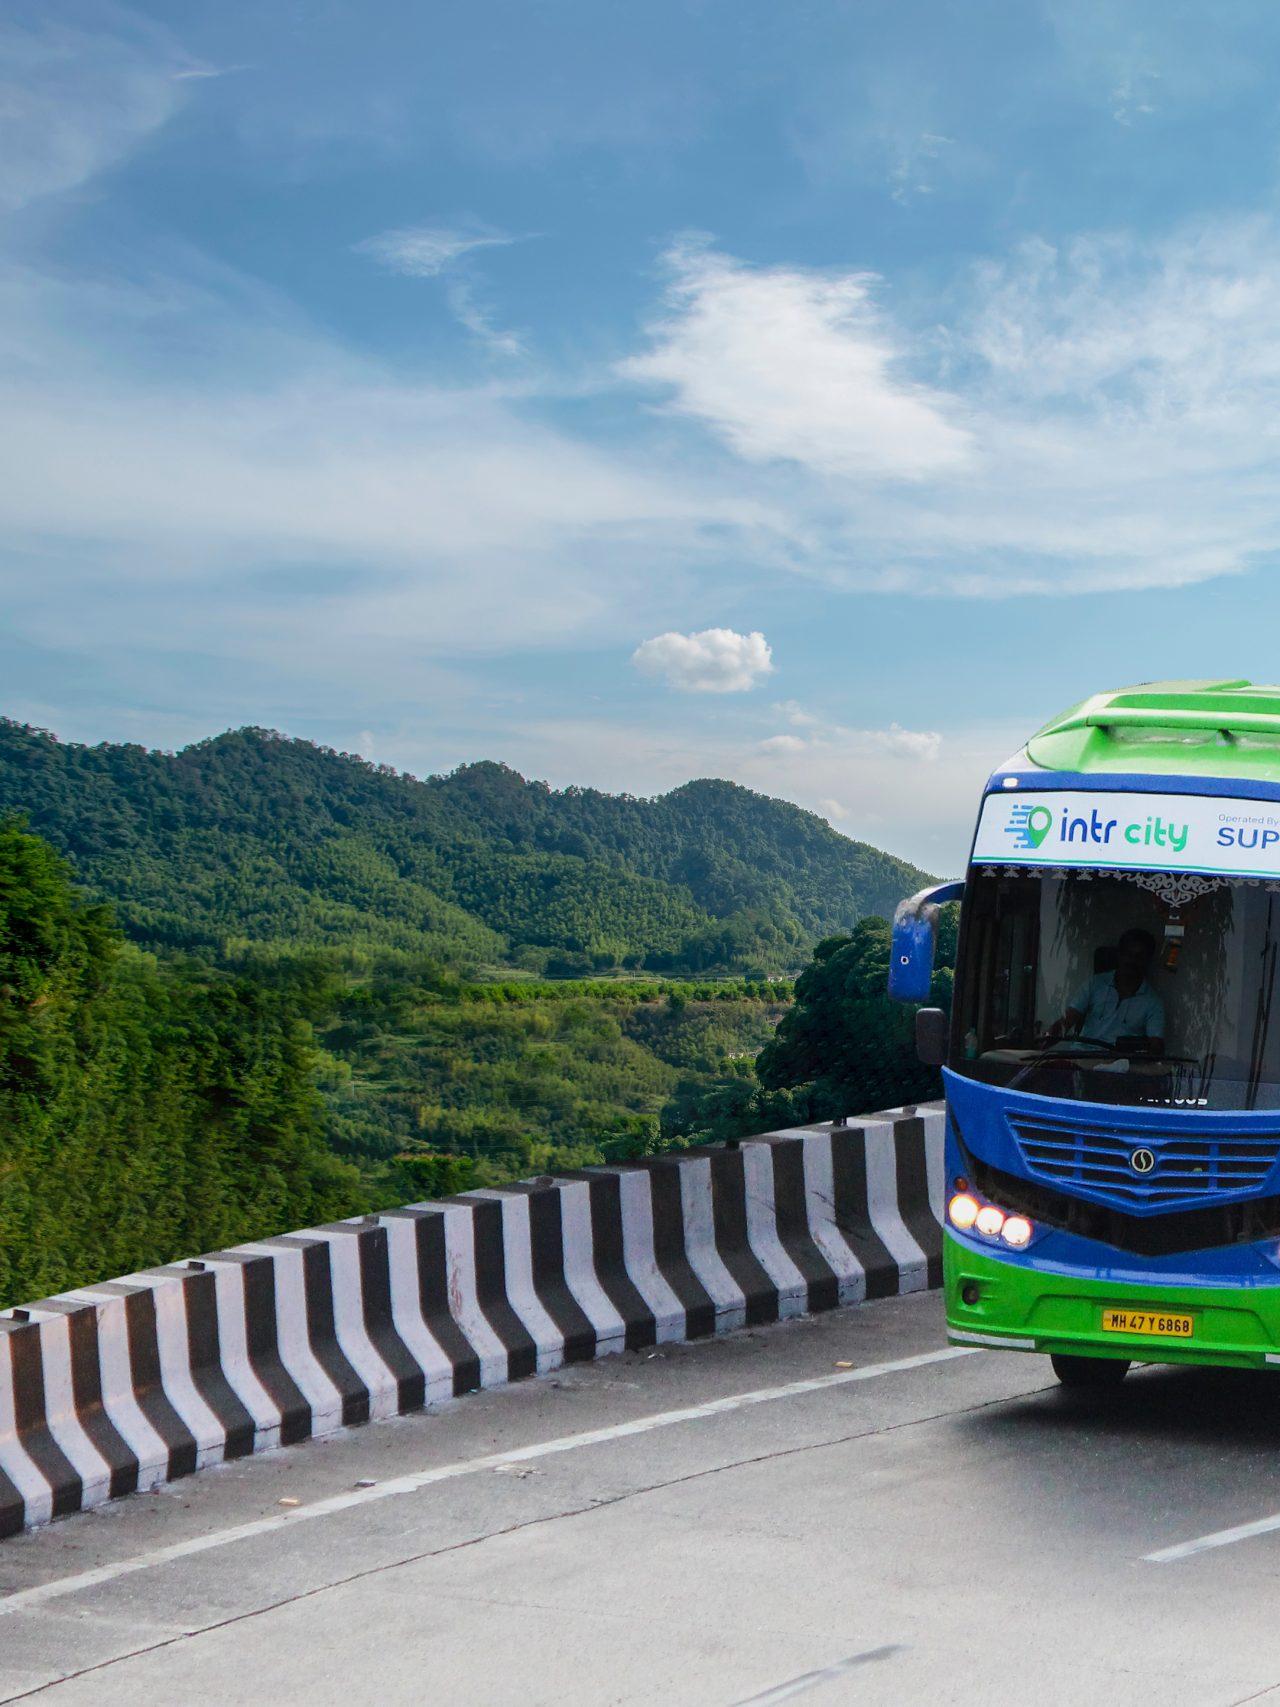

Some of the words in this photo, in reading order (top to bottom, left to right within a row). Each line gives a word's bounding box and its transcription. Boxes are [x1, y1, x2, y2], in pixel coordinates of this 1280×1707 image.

[1218, 813, 1264, 824] Operated
[1060, 807, 1118, 844] intr
[1124, 816, 1189, 853] city
[1111, 1314, 1127, 1329] MH
[1130, 1315, 1145, 1330] 47
[1148, 1317, 1155, 1331] Y
[1158, 1318, 1190, 1333] 6868
